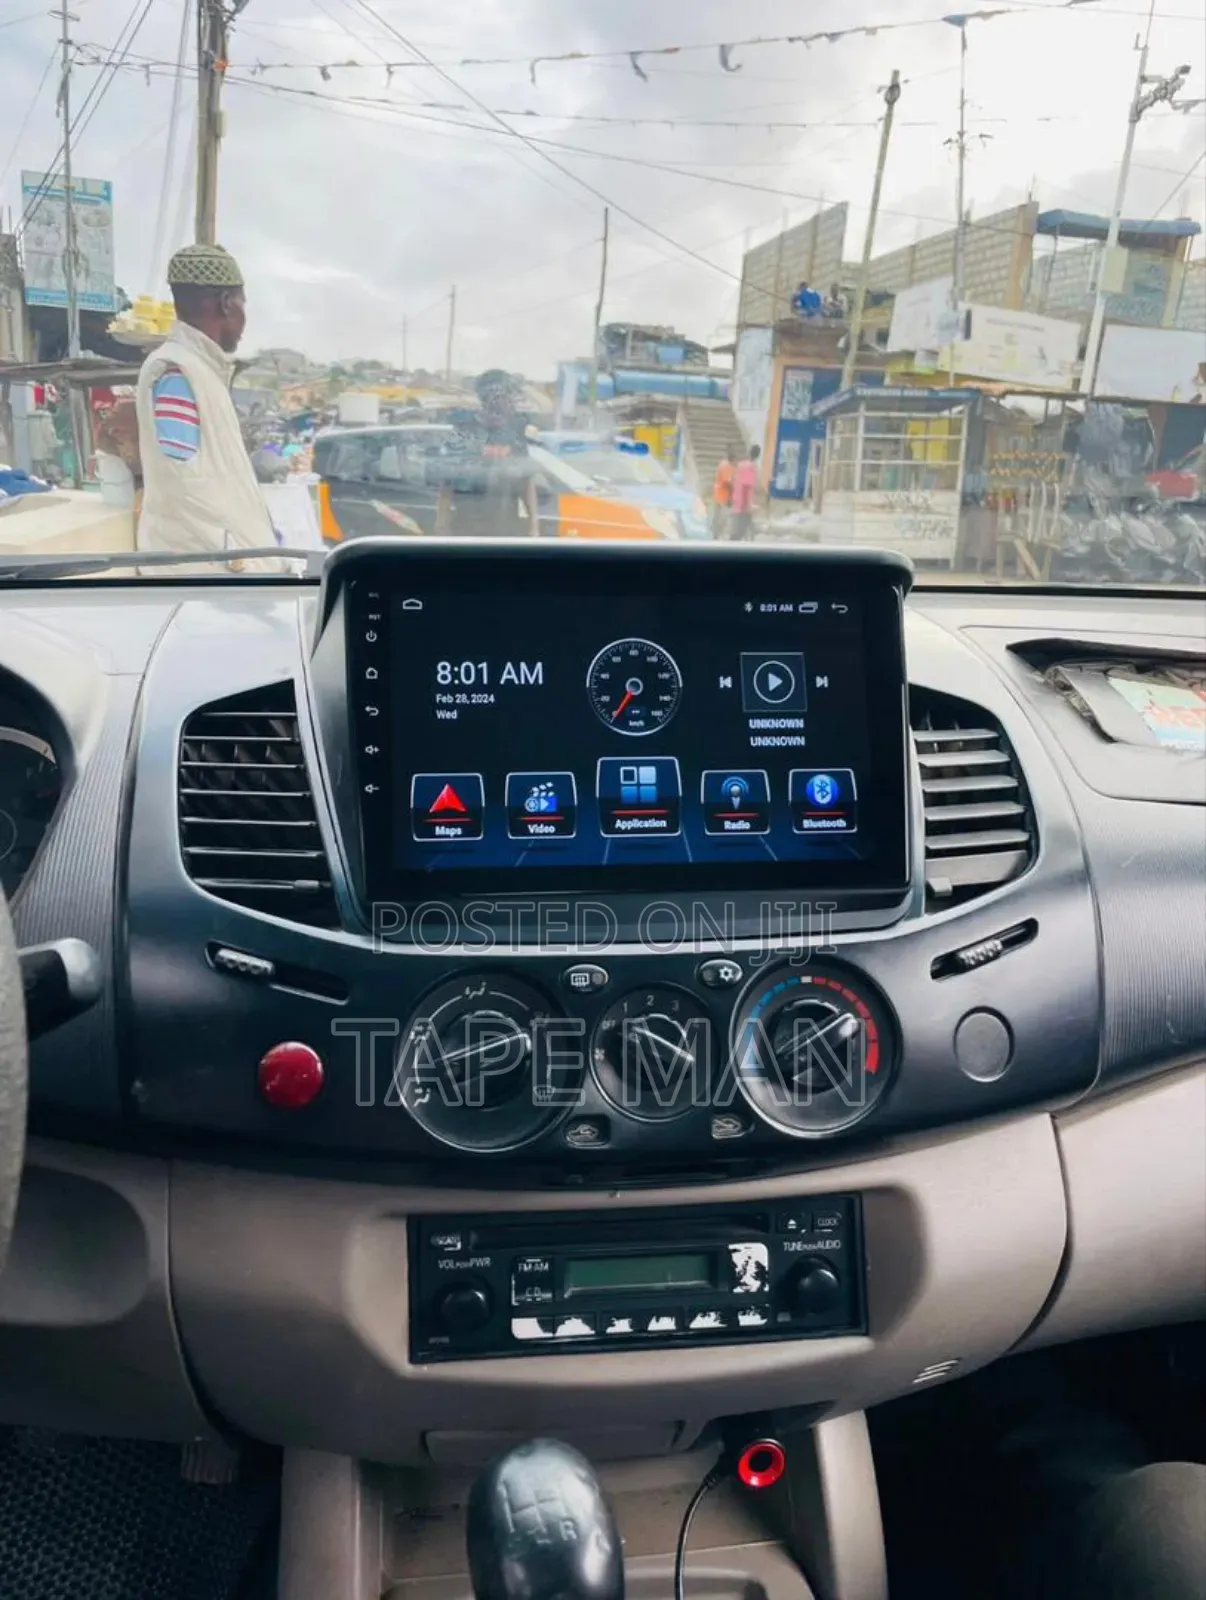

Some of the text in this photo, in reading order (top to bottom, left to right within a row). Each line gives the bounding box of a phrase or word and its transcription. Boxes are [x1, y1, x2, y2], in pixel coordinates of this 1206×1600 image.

[760, 603, 793, 613] 8:01 AM
[436, 661, 544, 685] 8:01 AM
[436, 693, 495, 705] Feb 28, 2024
[436, 709, 457, 720] Wed
[749, 718, 804, 730] UNKNOWN
[750, 736, 806, 748] UNKNOWN
[528, 822, 555, 835] Video
[614, 817, 667, 830] Application
[724, 819, 750, 831] Radio
[802, 818, 847, 830] Bluetooth
[435, 825, 462, 838] Maps
[646, 994, 655, 1007] 2
[817, 1239, 841, 1250] AUDIO
[438, 1259, 456, 1269] VOL
[470, 1257, 491, 1267] PWR
[560, 1519, 578, 1541] R
